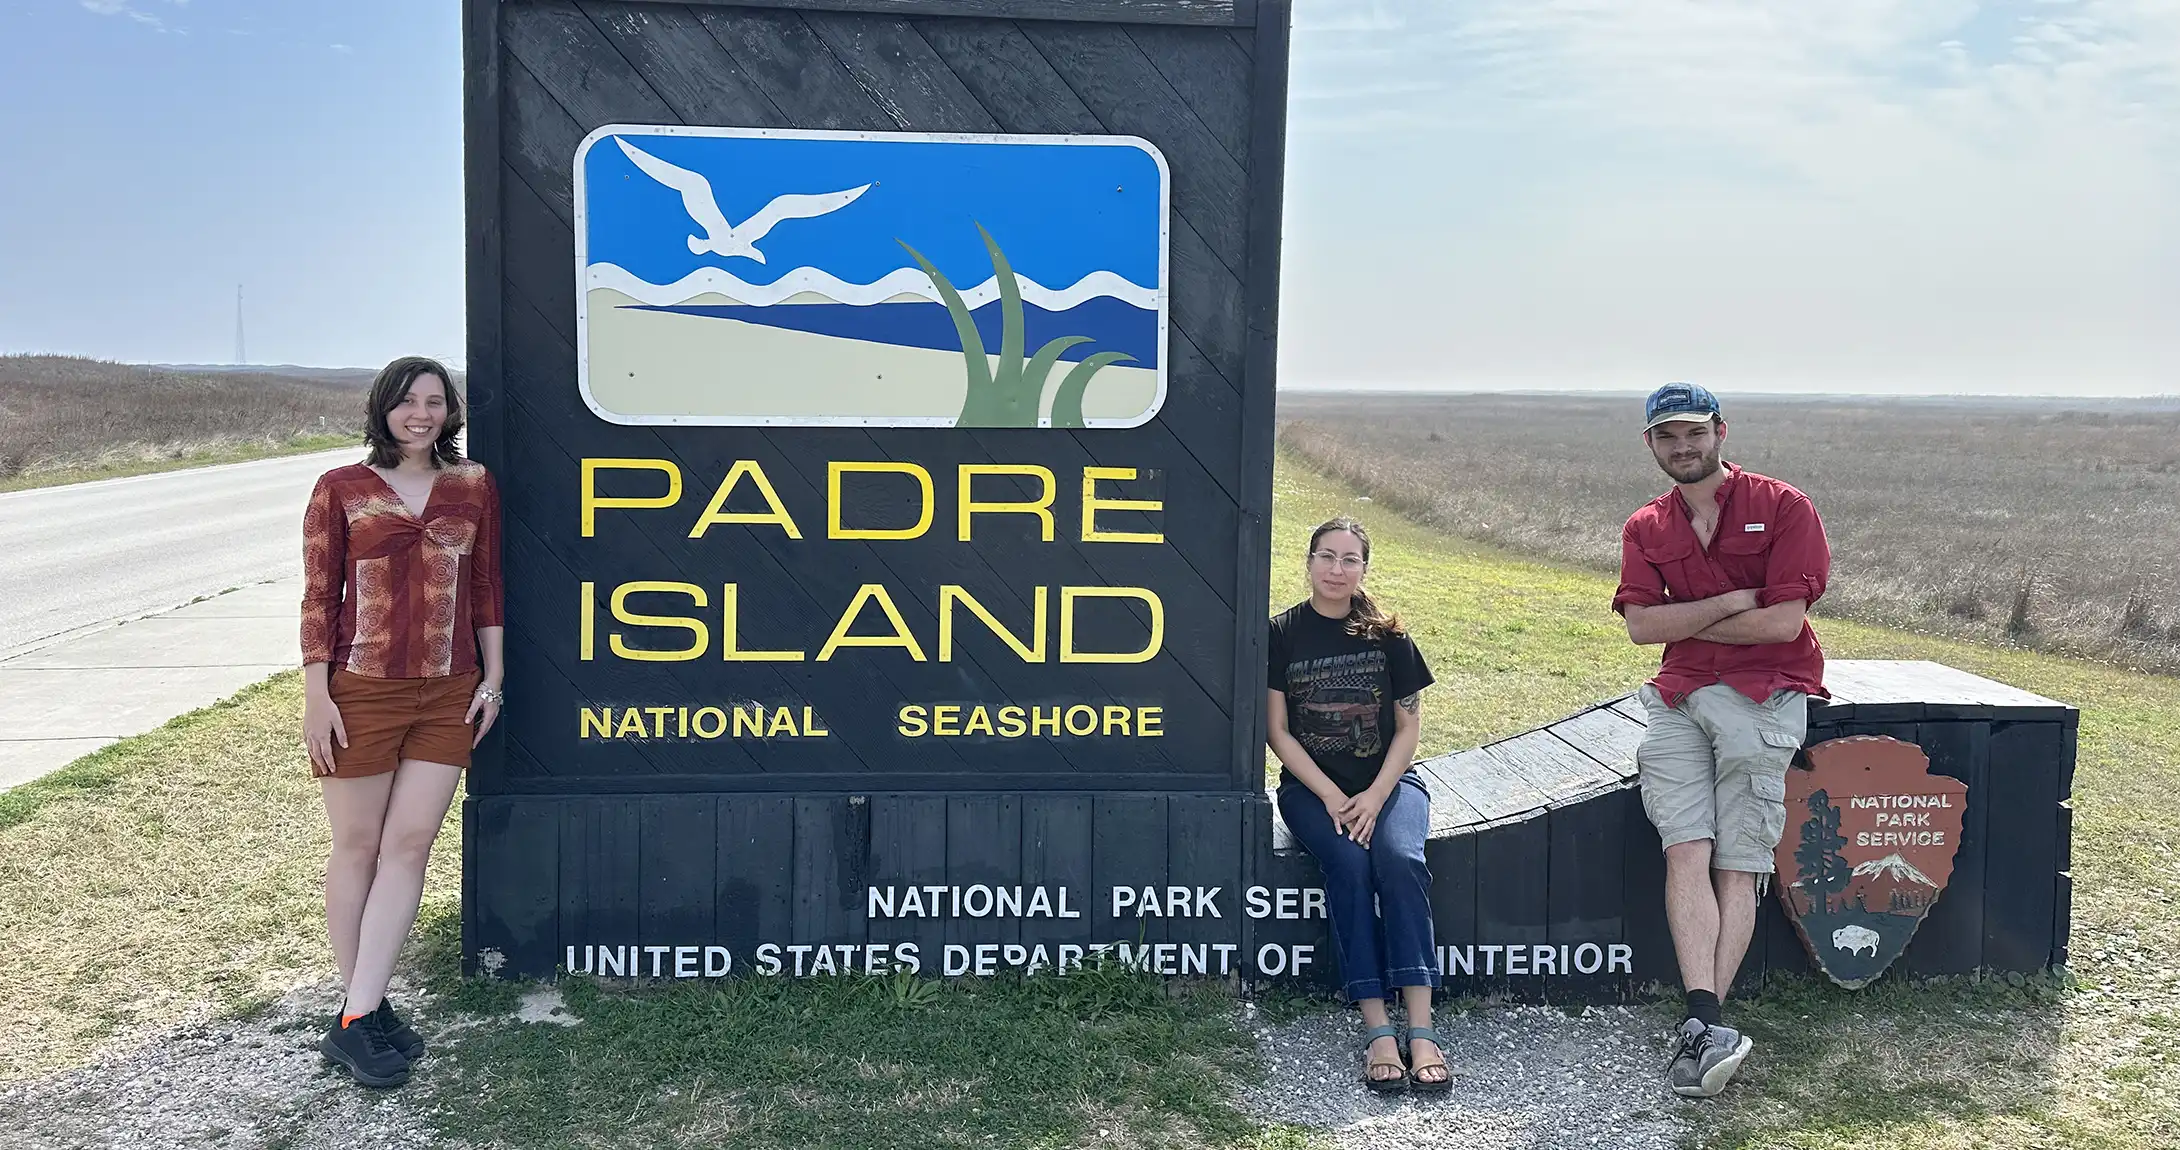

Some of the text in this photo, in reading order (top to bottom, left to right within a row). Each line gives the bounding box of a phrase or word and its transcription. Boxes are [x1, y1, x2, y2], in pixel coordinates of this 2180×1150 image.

[580, 458, 1165, 544] PADRE
[580, 581, 1165, 664] ISLAND
[580, 704, 1164, 739] NATIONAL SEASHORE
[1850, 794, 1953, 809] NATIONAL
[1876, 812, 1931, 827] PARK
[1856, 831, 1945, 847] SERVICE
[867, 885, 1080, 918] NATIONAL
[1112, 885, 1223, 918] PARK
[566, 942, 1634, 978] UNITED STATES DEPARTMENT OF INTERIOR
